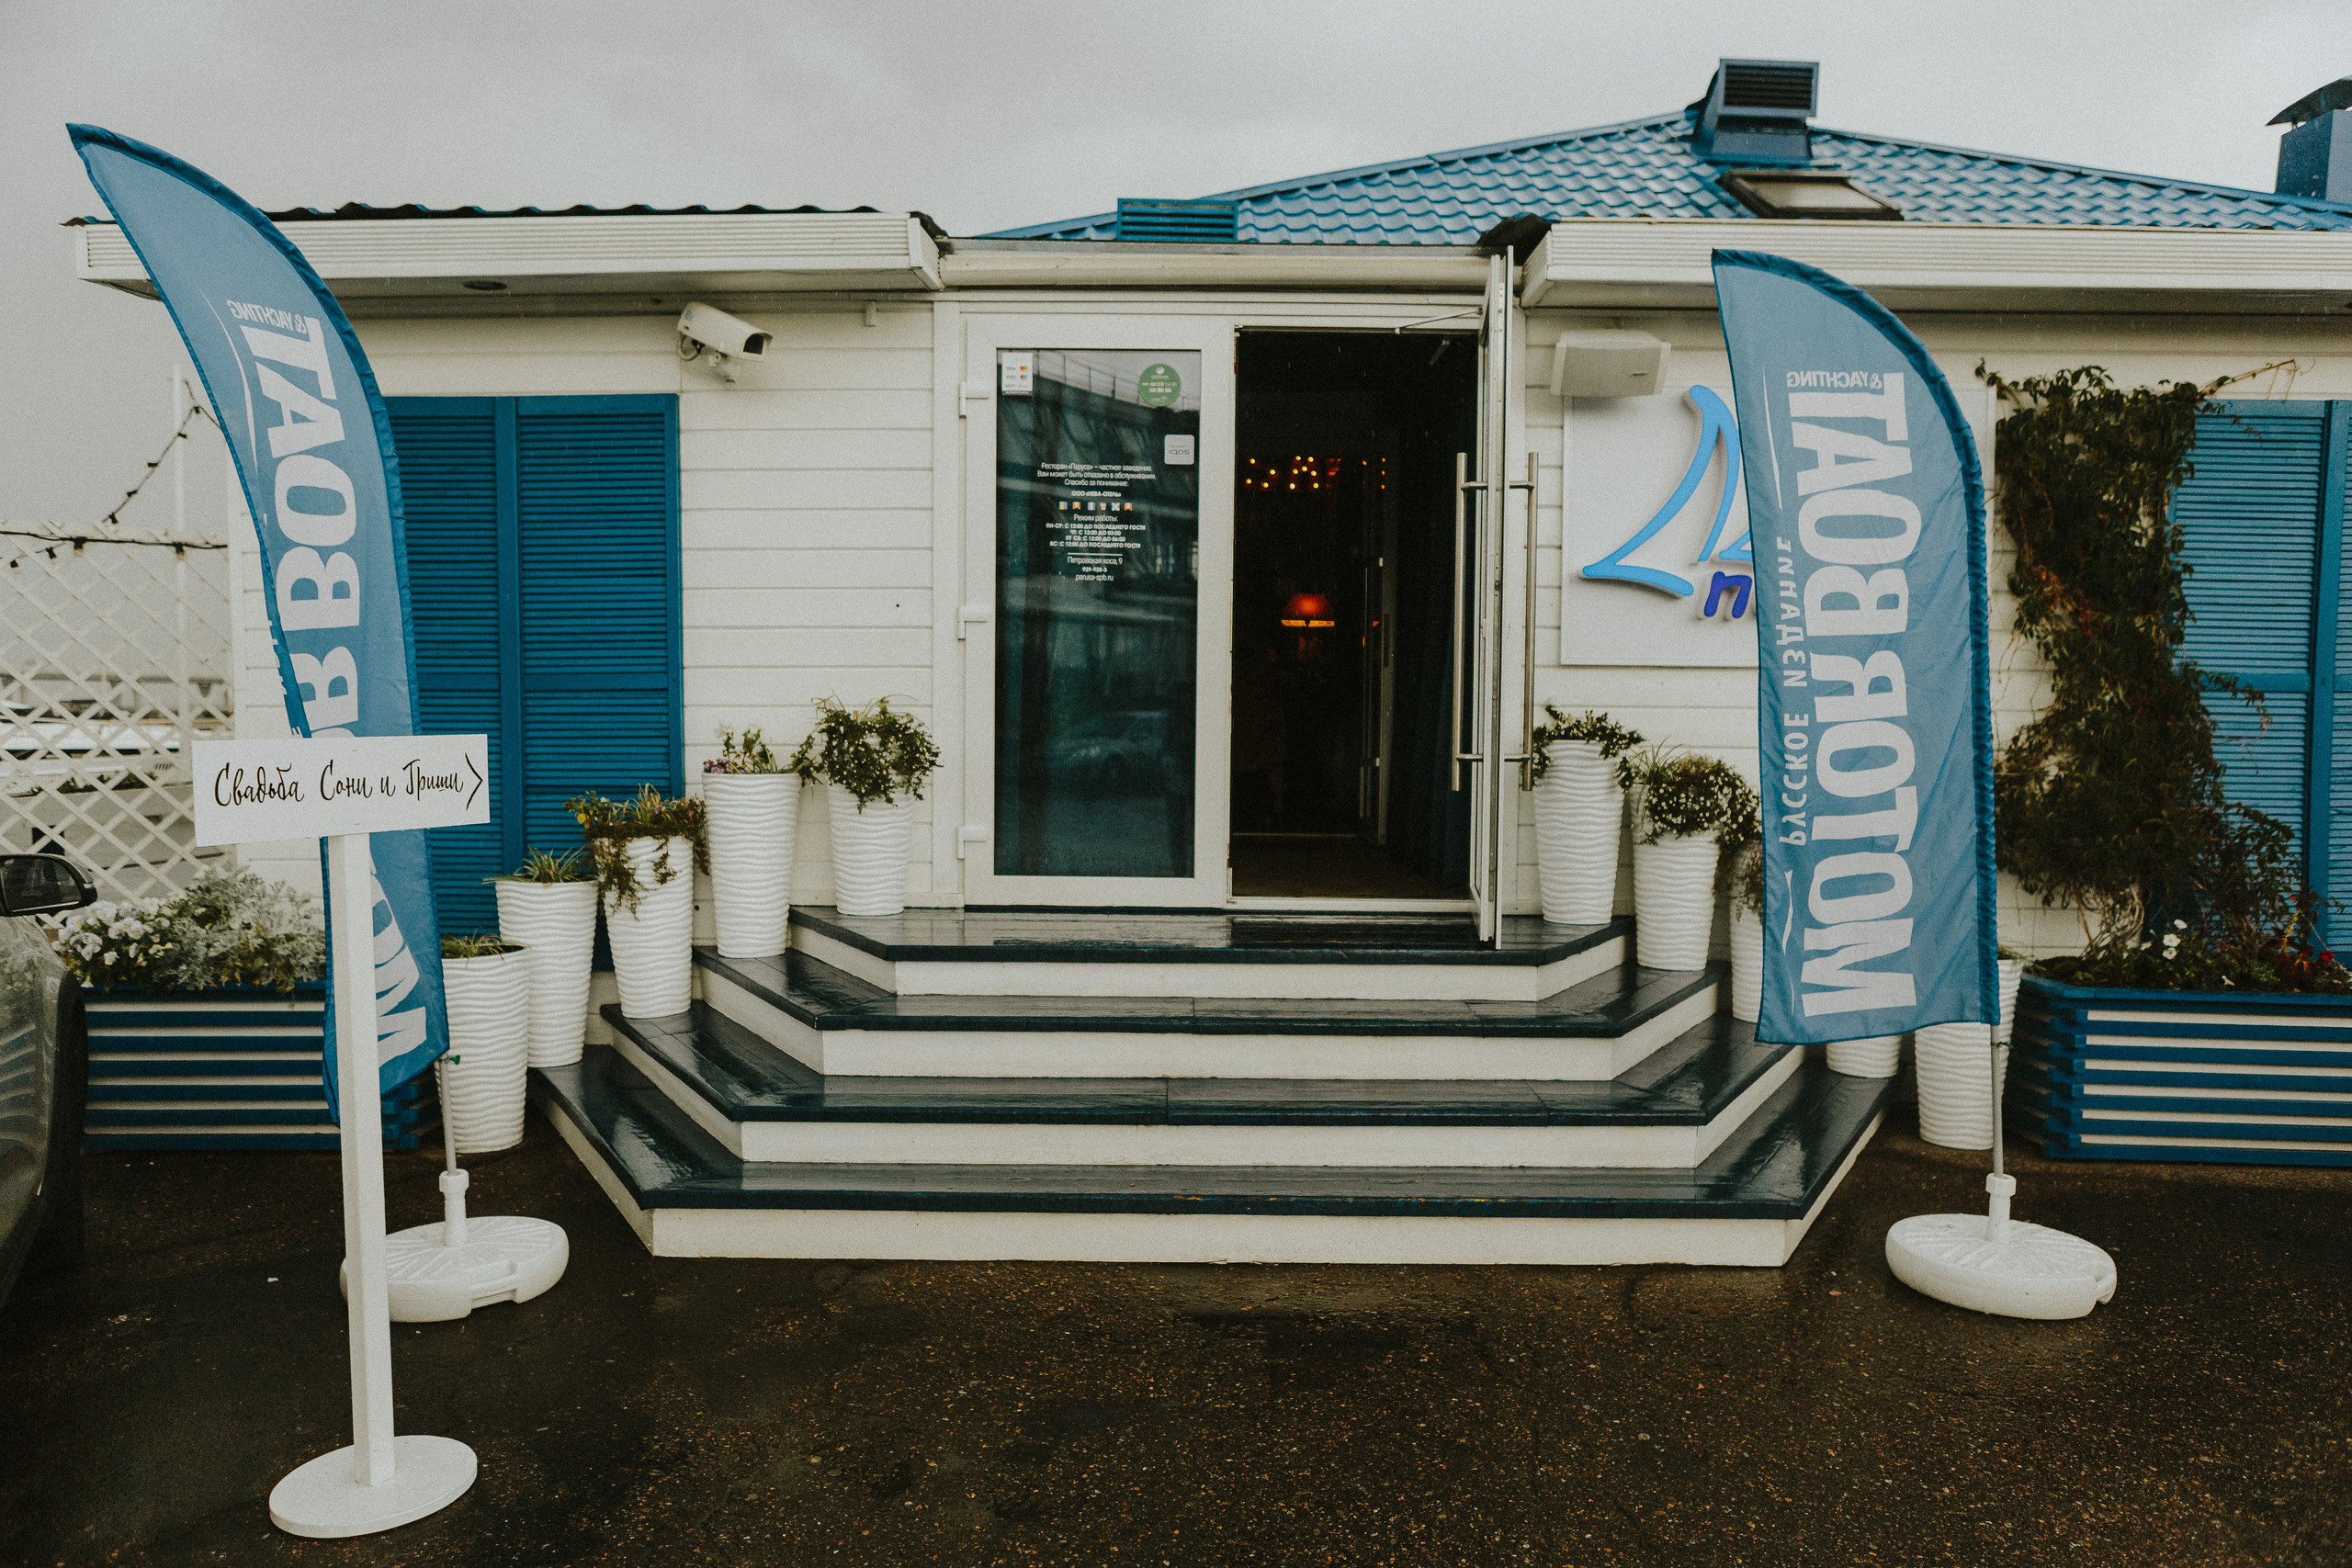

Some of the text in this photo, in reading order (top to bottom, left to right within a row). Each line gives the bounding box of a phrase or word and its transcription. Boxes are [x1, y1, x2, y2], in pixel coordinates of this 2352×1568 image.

[1041, 462, 1067, 471] Ресторан
[1067, 556, 1102, 565] Петровская
[214, 758, 464, 807] Свадьба Сони и Гриши
